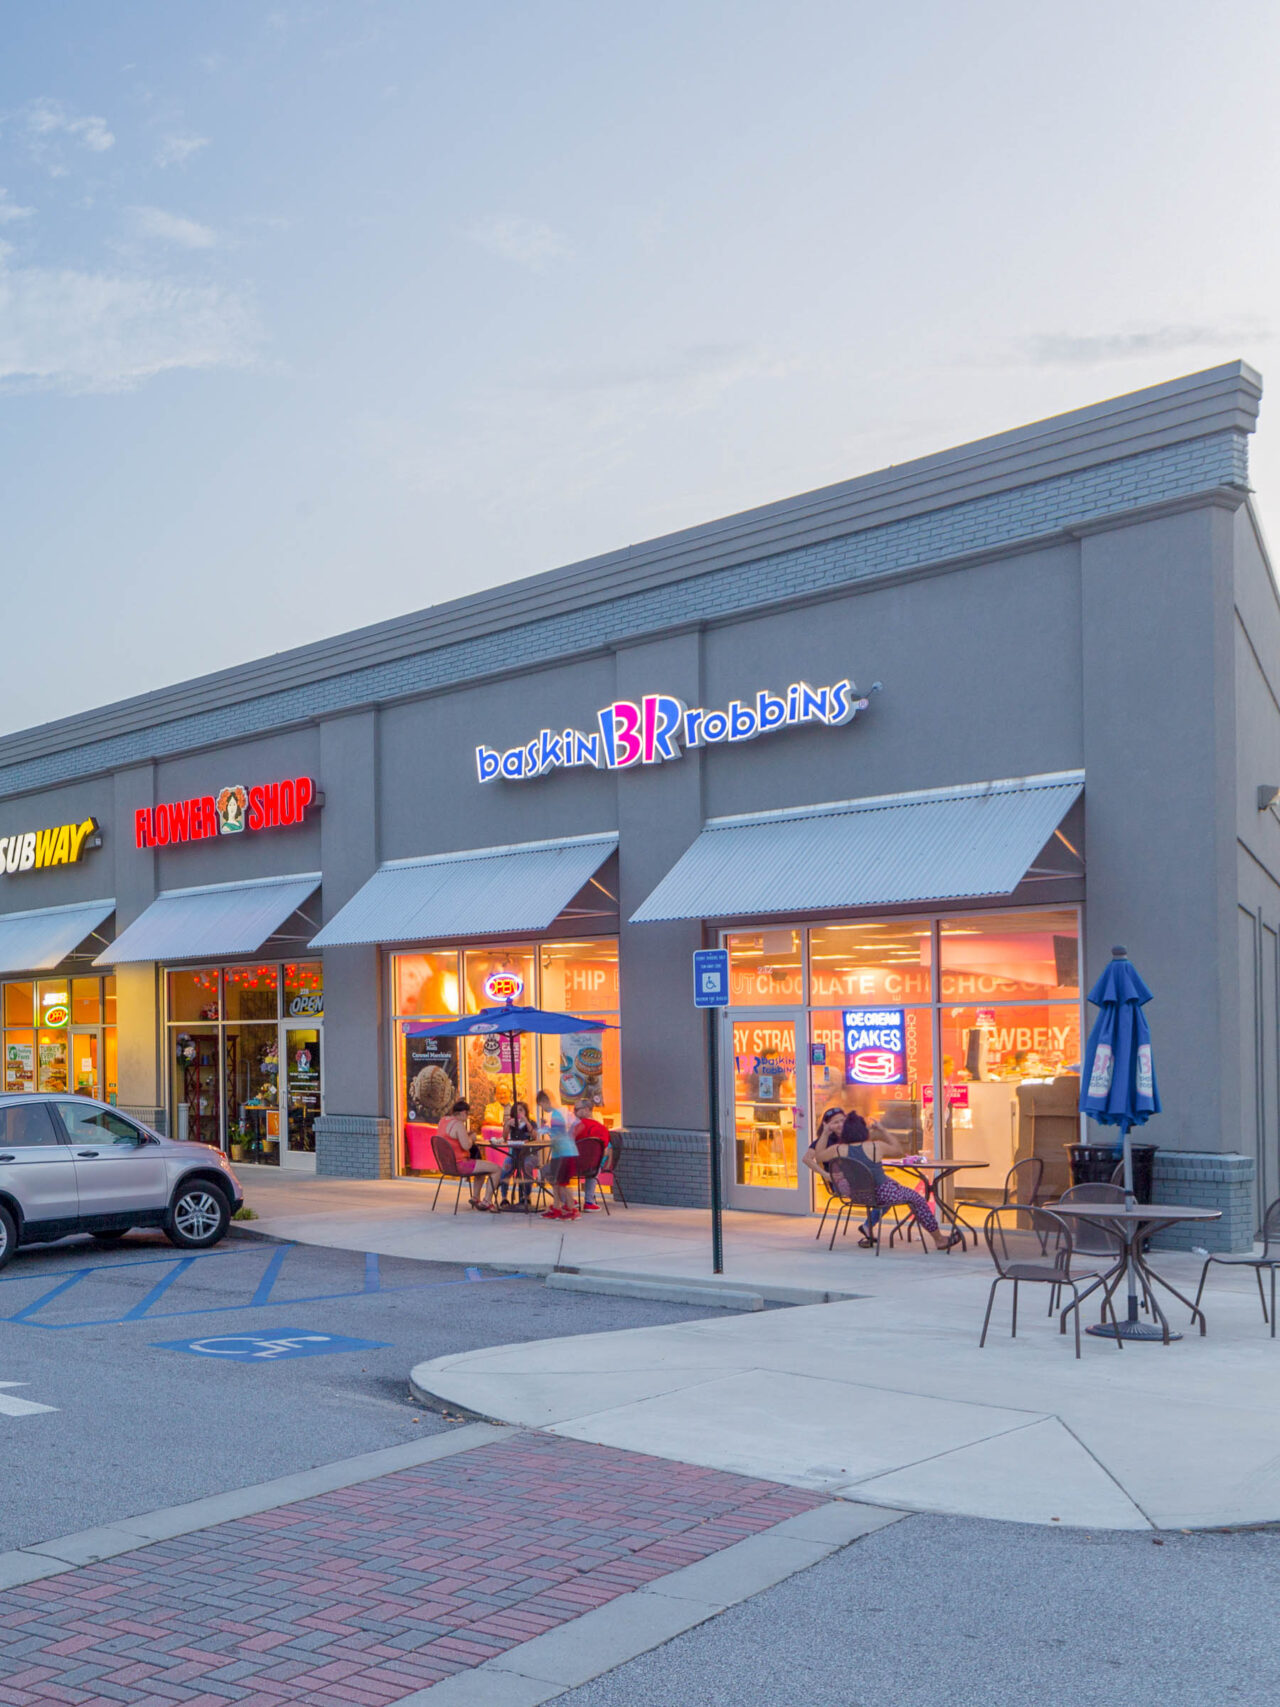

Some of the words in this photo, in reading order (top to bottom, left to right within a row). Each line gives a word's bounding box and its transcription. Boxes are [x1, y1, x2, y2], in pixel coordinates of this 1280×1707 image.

[476, 730, 600, 783] baskin
[597, 694, 683, 768] BR
[135, 796, 217, 848] FLOWER
[248, 777, 312, 830] SHOP
[489, 978, 518, 995] OPEN
[292, 996, 324, 1012] OPEN
[846, 1012, 864, 1026] ICE
[863, 1012, 900, 1026] CREAM
[847, 1028, 902, 1051] CAKES
